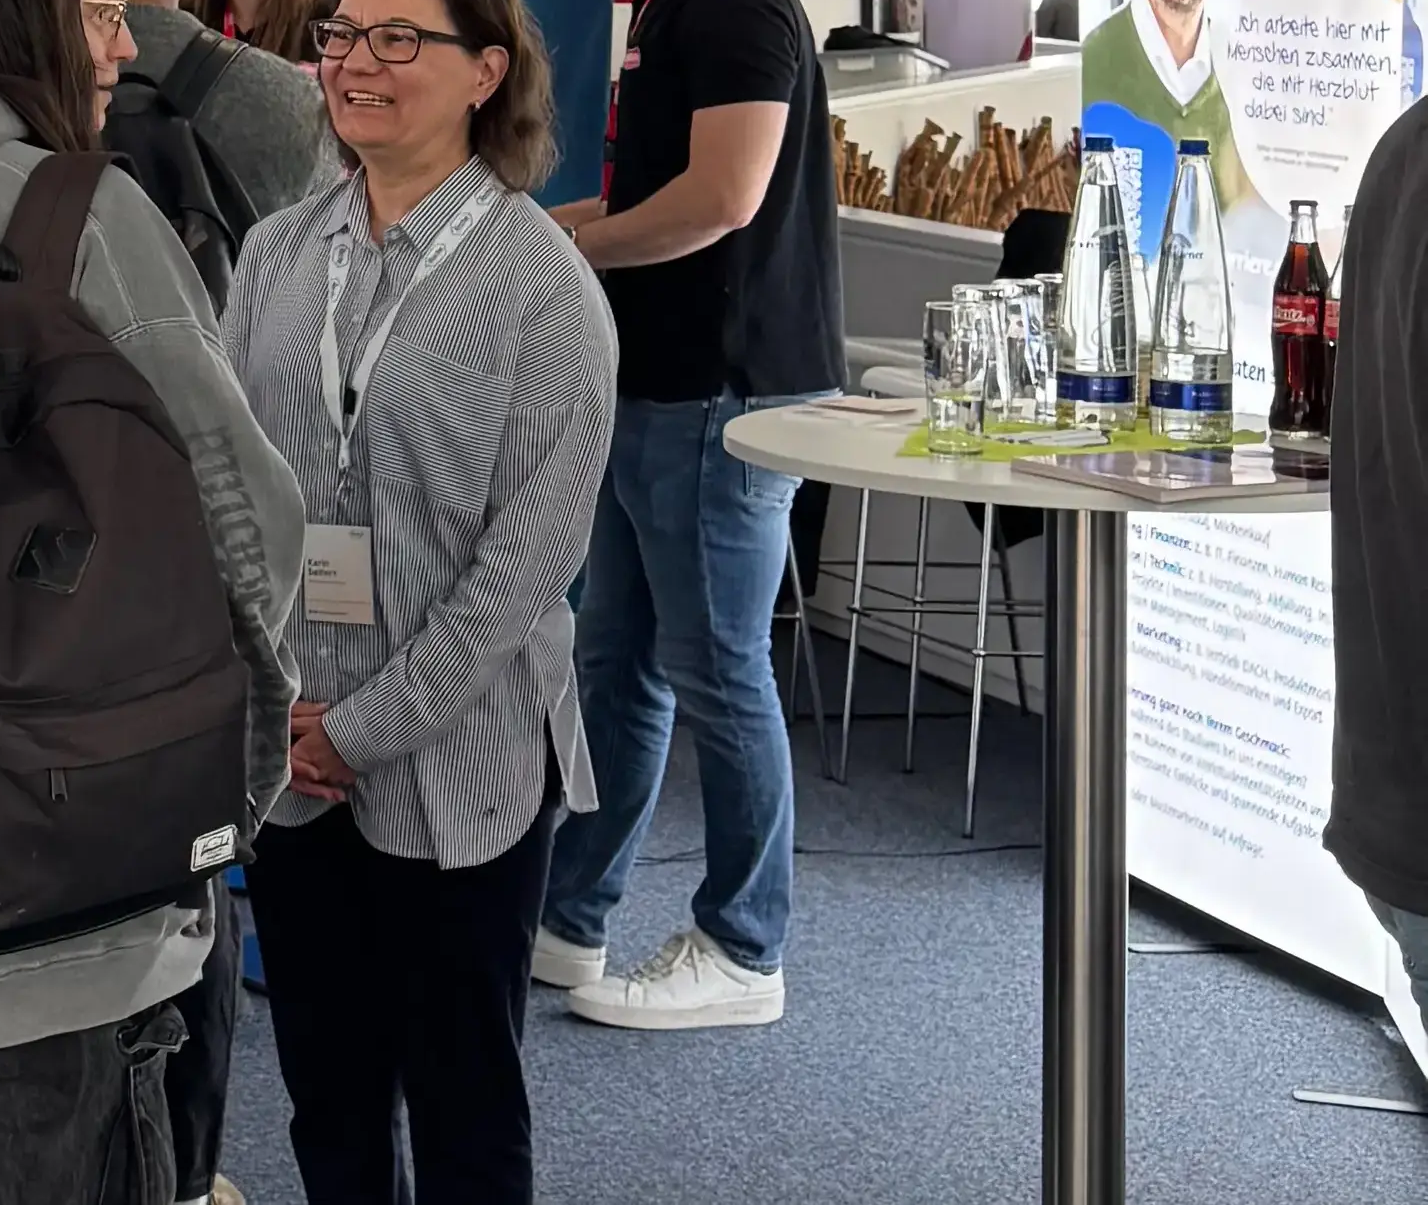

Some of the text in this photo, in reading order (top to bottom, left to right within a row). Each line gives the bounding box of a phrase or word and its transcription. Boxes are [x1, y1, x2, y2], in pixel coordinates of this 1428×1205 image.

[1265, 14, 1319, 37] arbeite
[1326, 16, 1355, 40] hier
[1252, 70, 1275, 92] die
[1309, 78, 1380, 101] Herzblut
[1244, 98, 1287, 122] dabei
